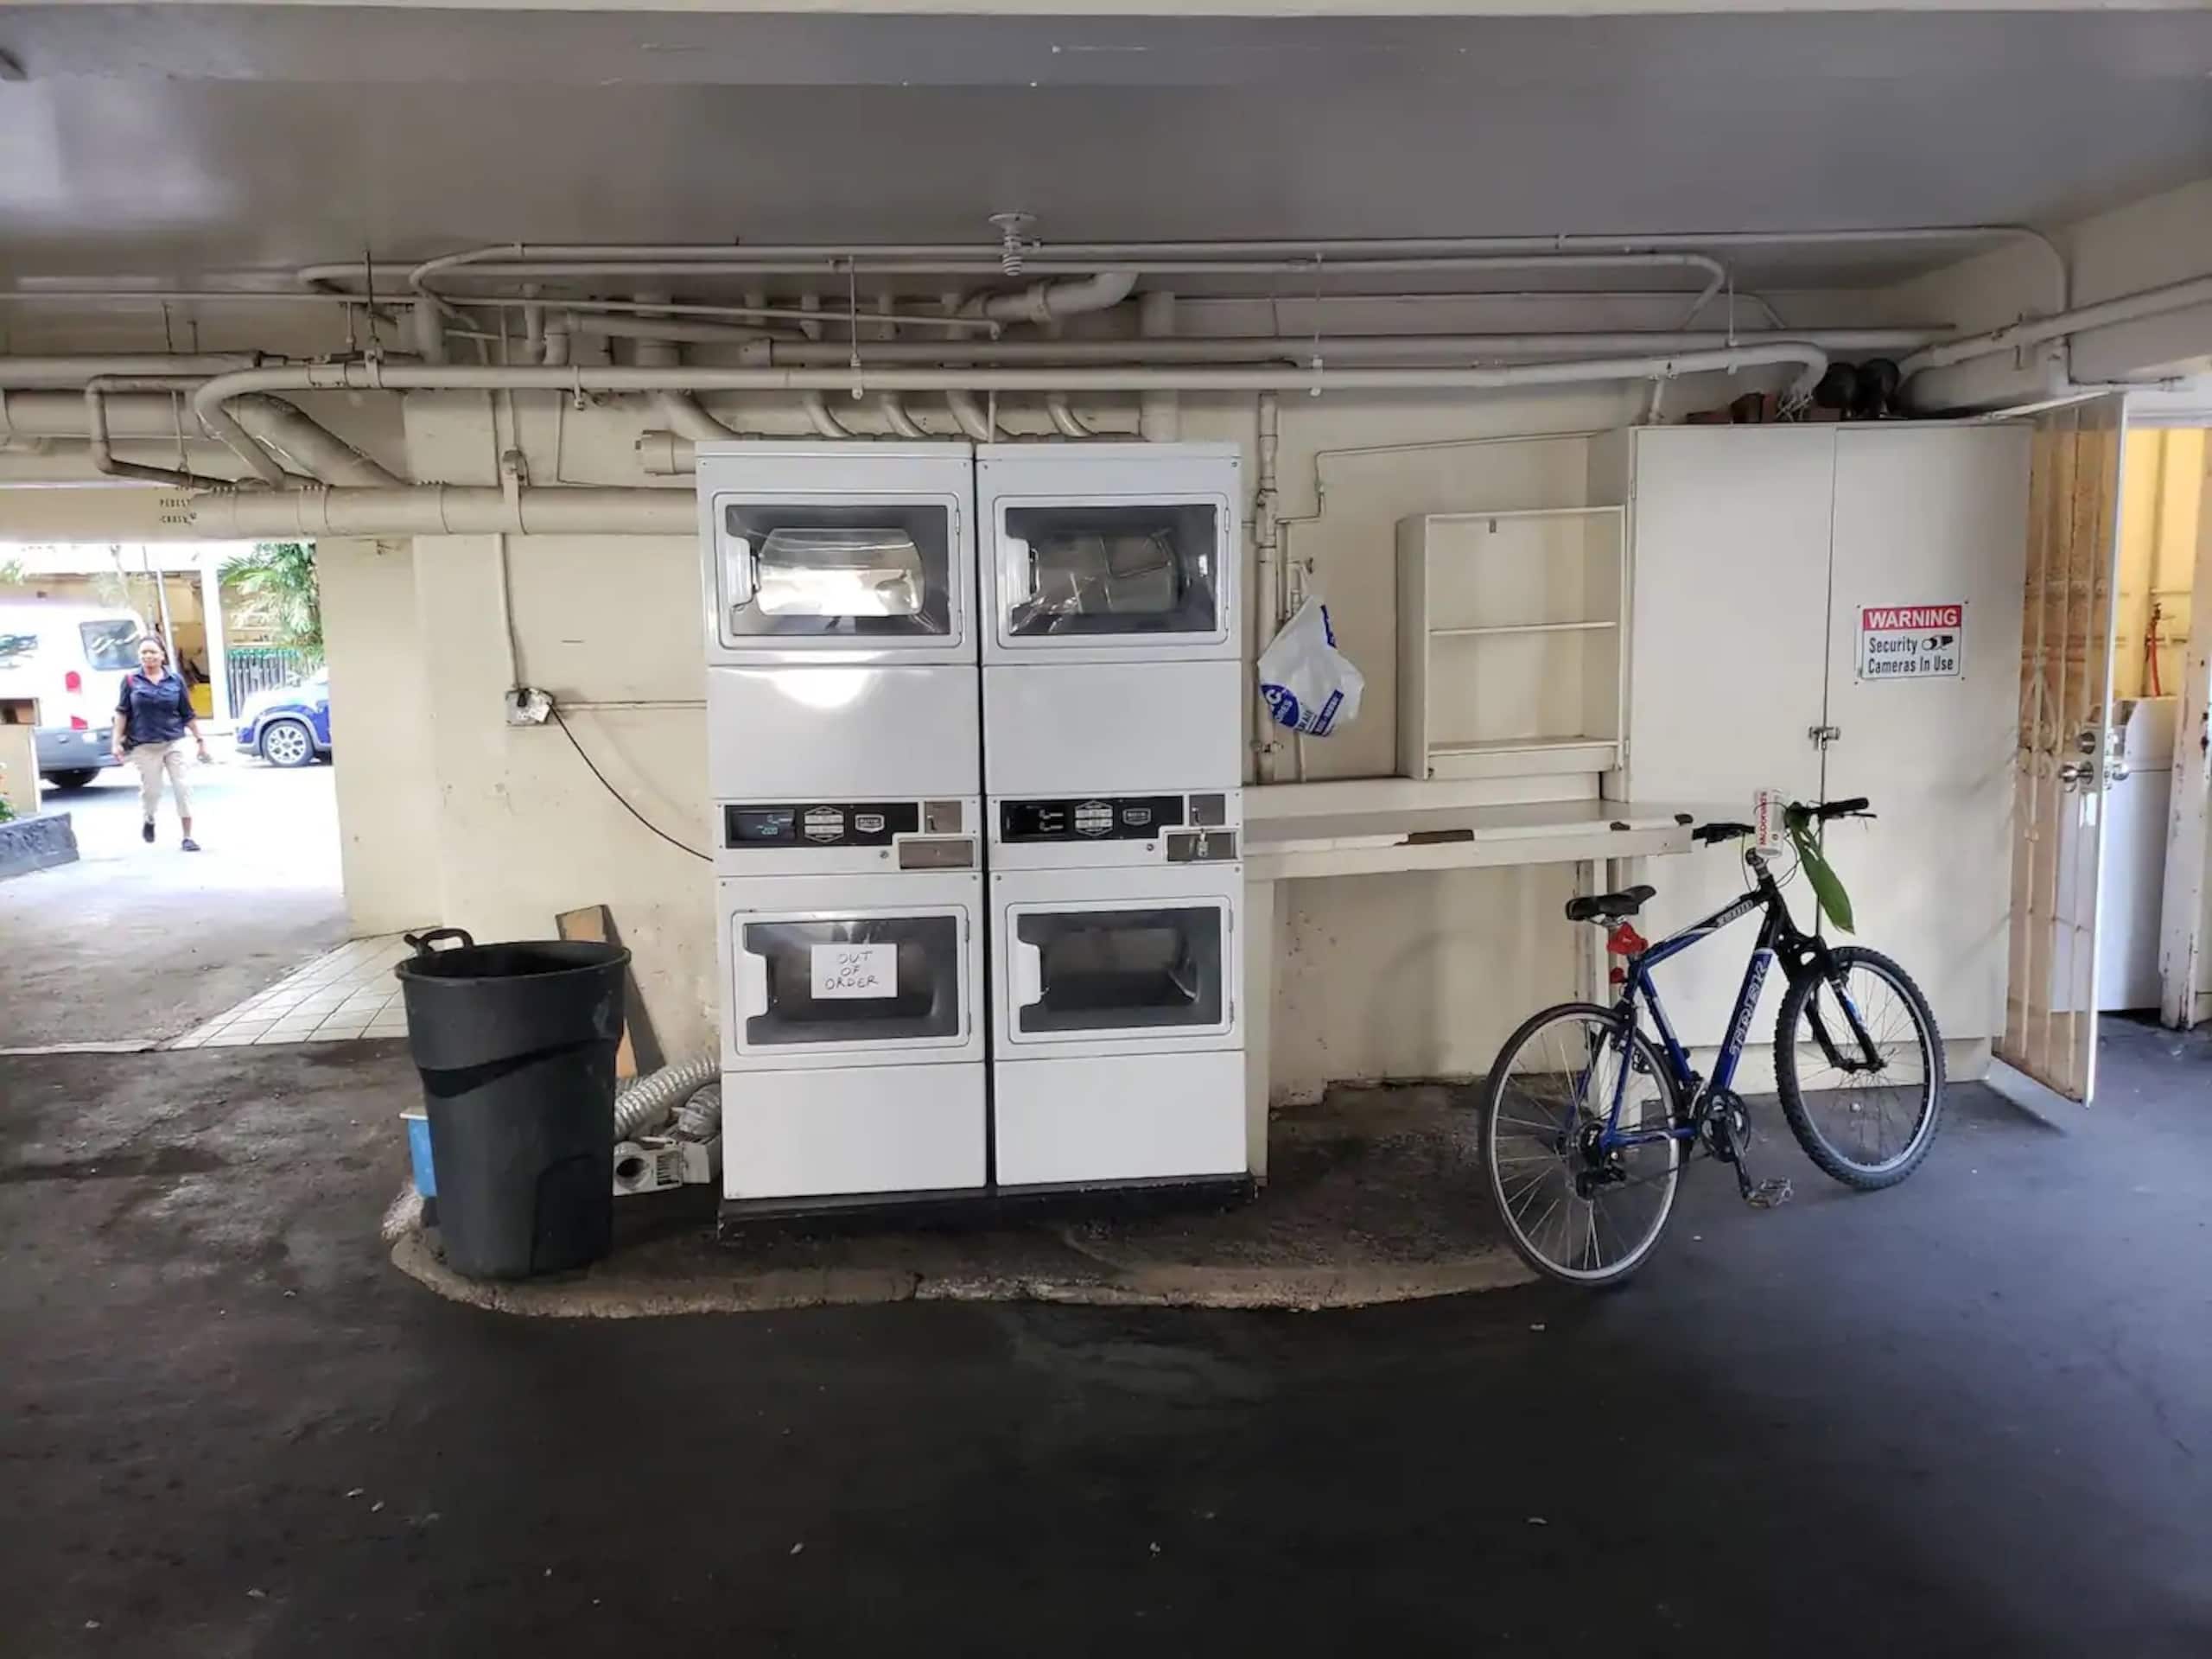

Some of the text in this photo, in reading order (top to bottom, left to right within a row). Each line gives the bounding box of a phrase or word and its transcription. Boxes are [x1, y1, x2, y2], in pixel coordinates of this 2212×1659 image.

[1868, 608, 1958, 628] WARNING
[1869, 636, 1918, 655] Security
[1868, 655, 1954, 674] Cameras In Use
[839, 950, 874, 964] OUT
[841, 964, 861, 977] OF
[825, 975, 880, 990] ORDER
